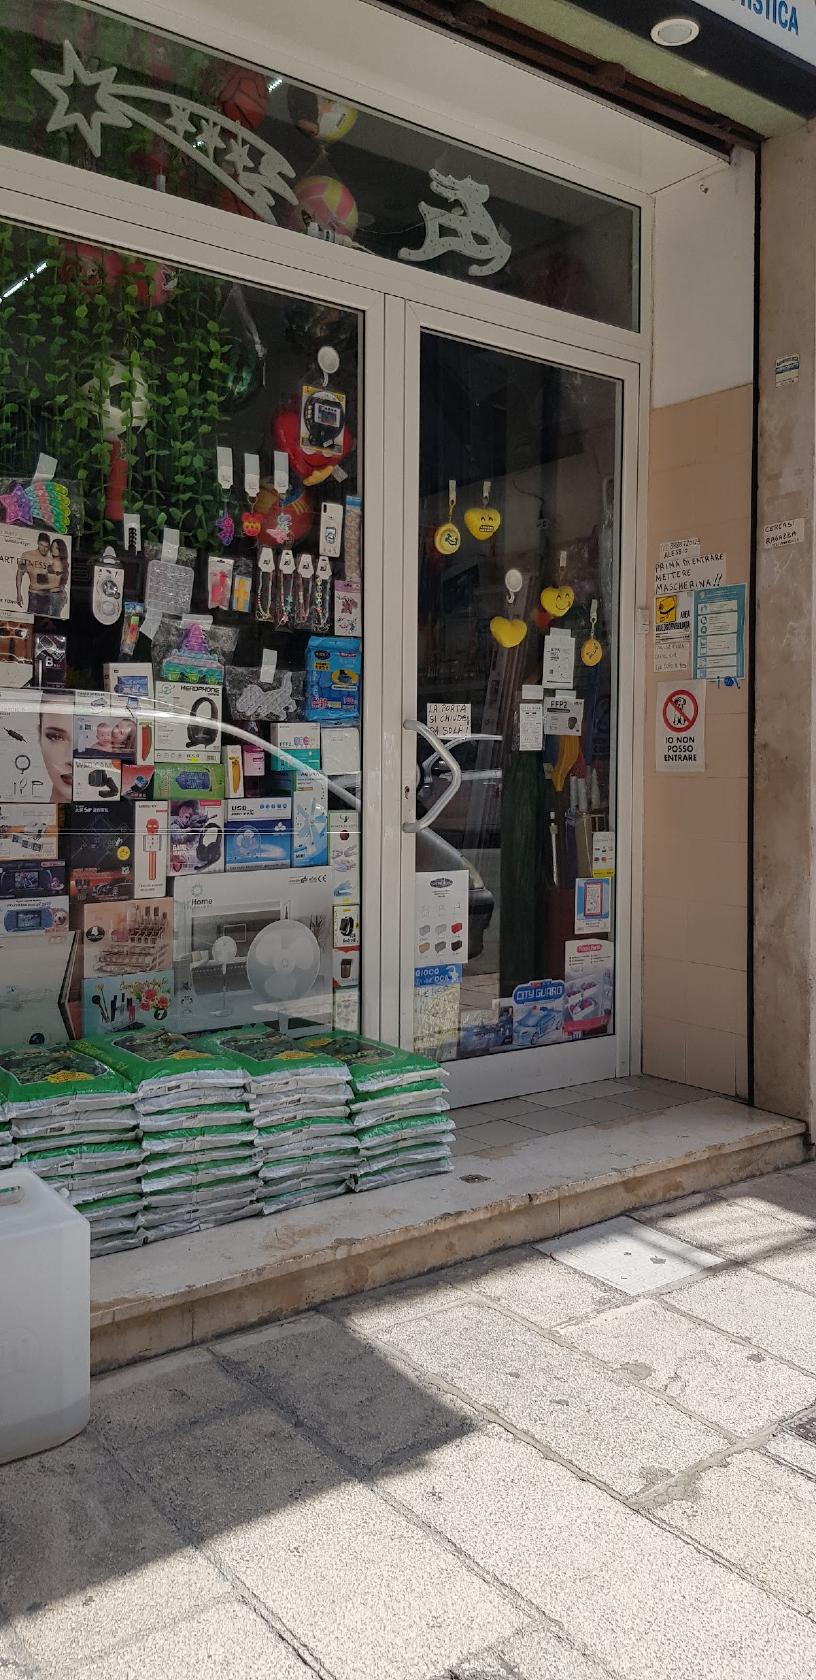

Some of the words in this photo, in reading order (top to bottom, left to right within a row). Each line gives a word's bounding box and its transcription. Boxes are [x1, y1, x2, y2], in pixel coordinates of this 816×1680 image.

[656, 561, 680, 573] PRIMA
[692, 553, 724, 565] ENTRARE
[656, 569, 691, 581] METTERE
[676, 736, 695, 744] NON
[667, 745, 694, 753] POSSO
[663, 754, 697, 762] ENTRARE
[192, 898, 213, 906] Home
[416, 968, 440, 977] GIOCO
[516, 989, 535, 1001] CITY
[536, 986, 563, 998] GUARD
